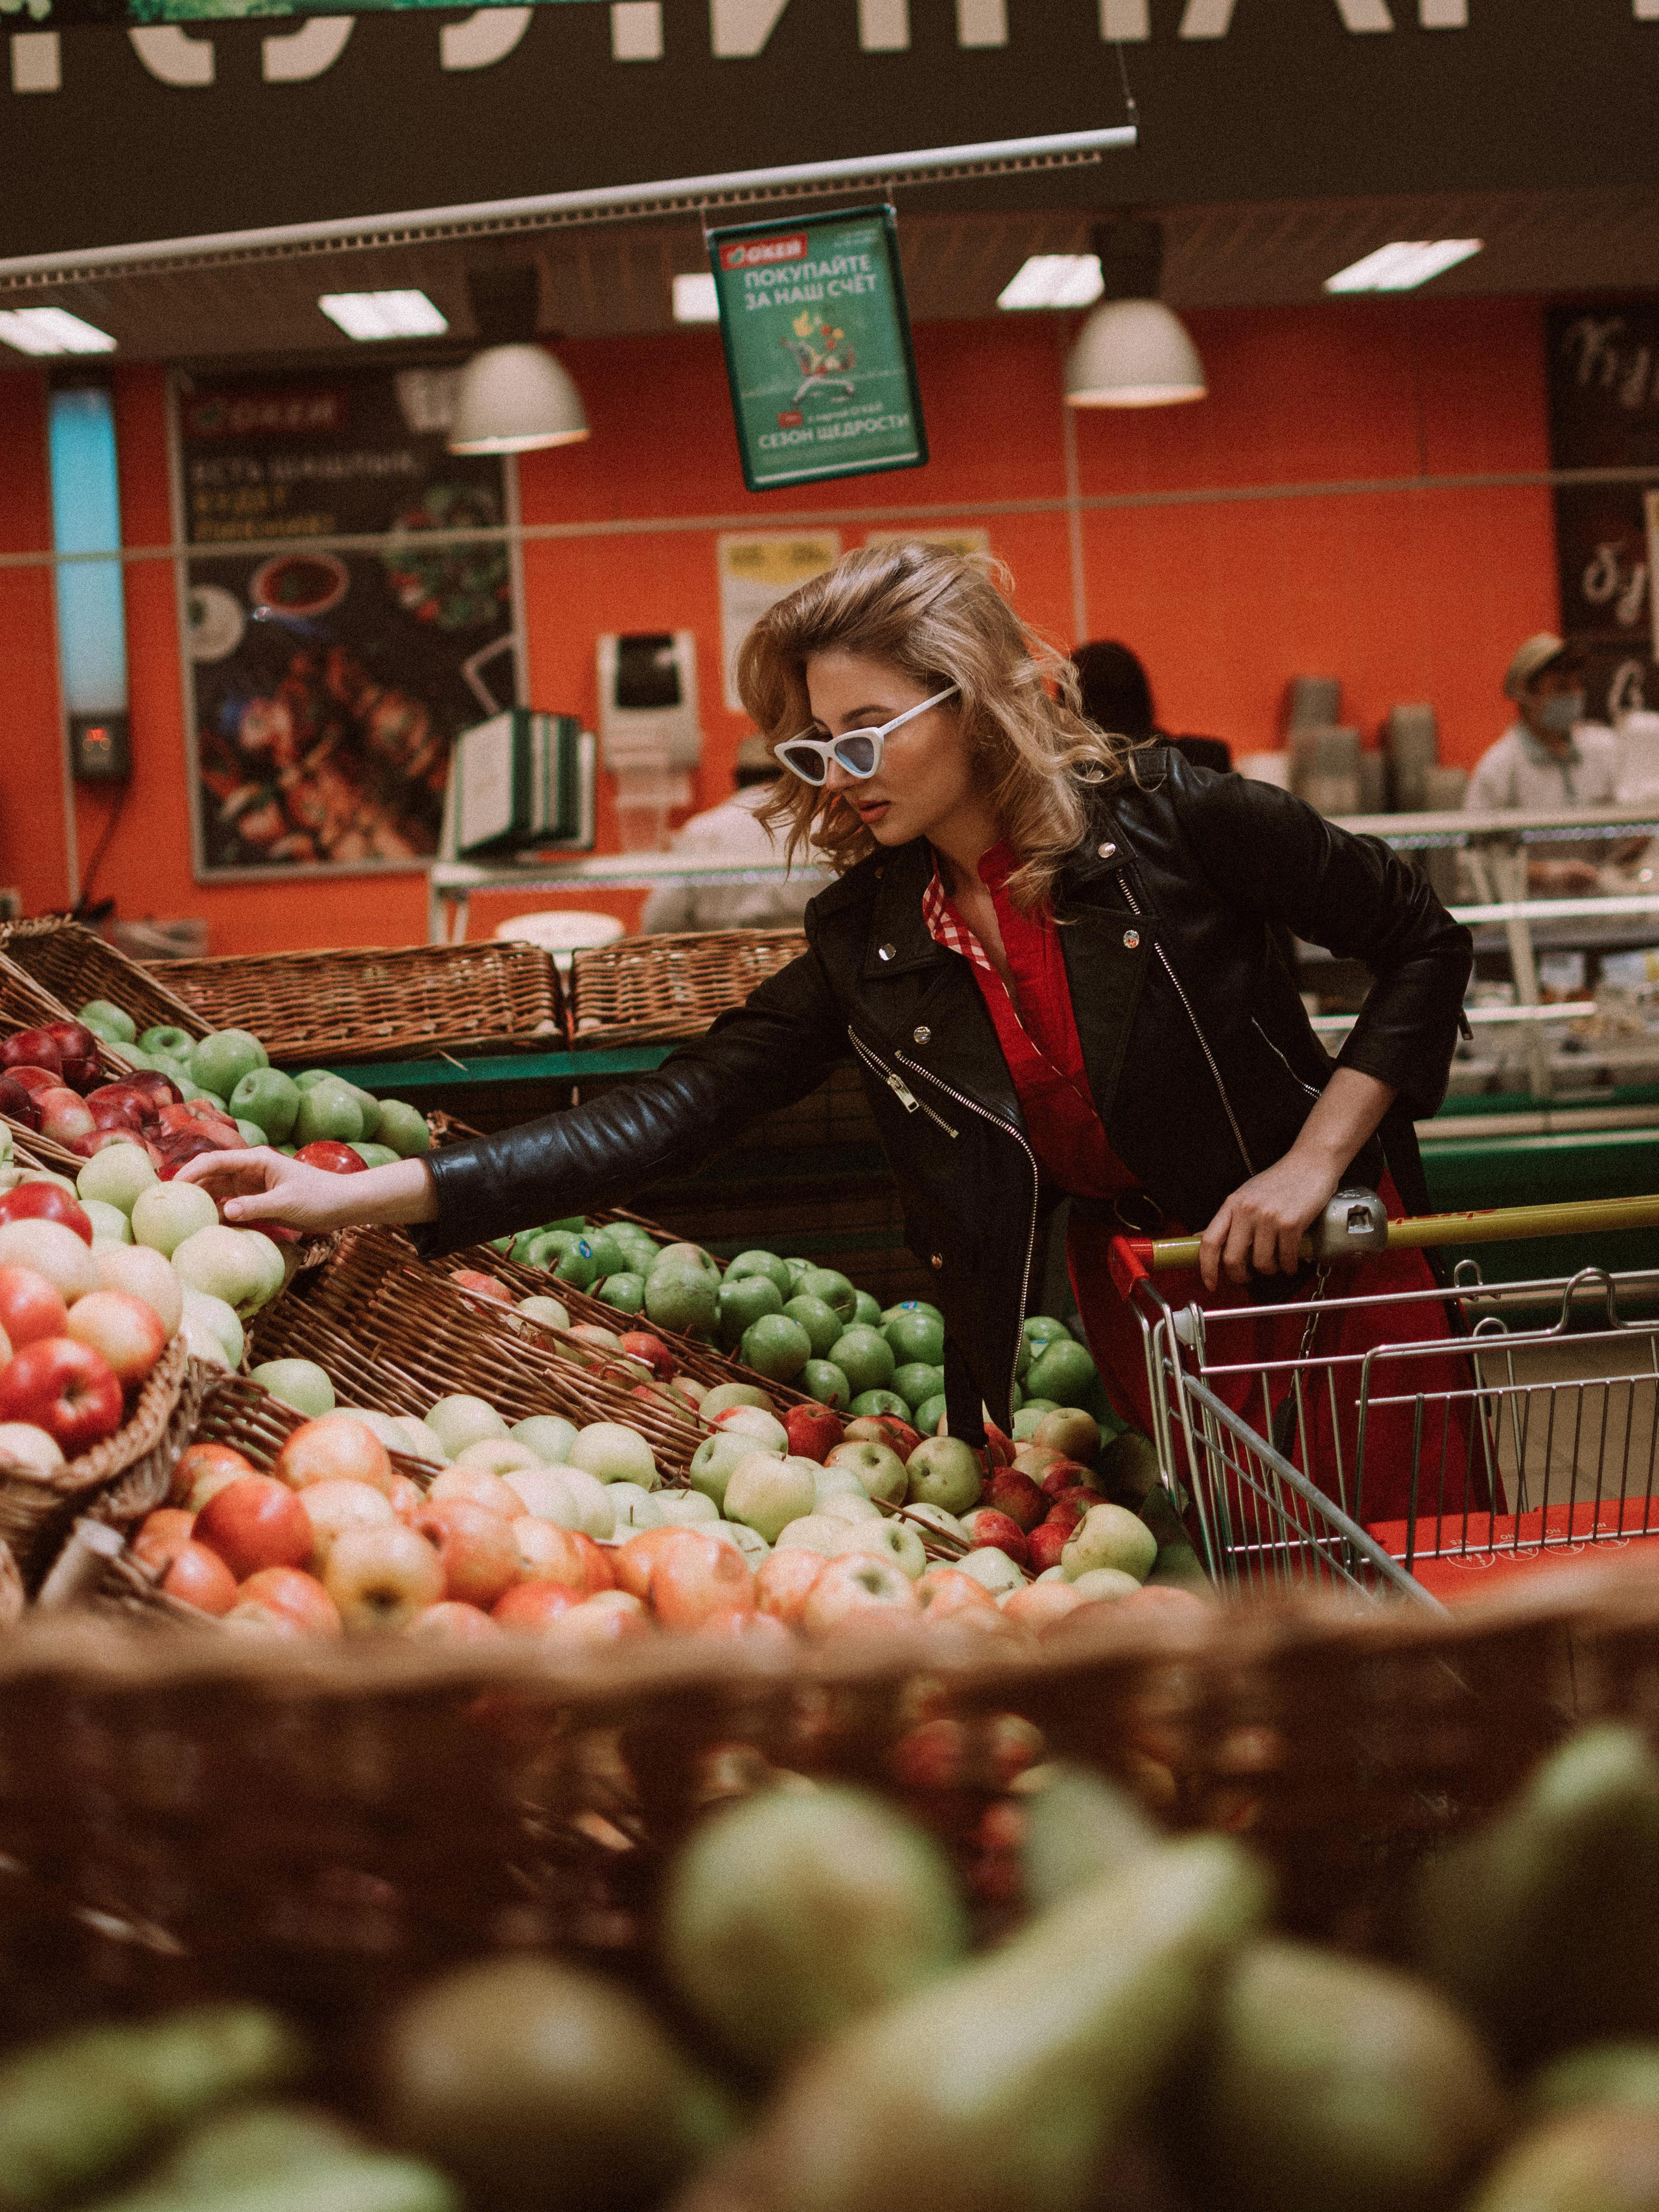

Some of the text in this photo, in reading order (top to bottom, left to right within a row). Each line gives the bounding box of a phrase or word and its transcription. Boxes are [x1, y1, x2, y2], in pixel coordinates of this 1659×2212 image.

[745, 254, 872, 288] ПОКУПАЙТЕ
[745, 292, 771, 310] ЗА
[774, 283, 824, 305] НАШ
[758, 428, 814, 448] СЕЗОН
[817, 414, 910, 441] ЩЕДРОСТИ
